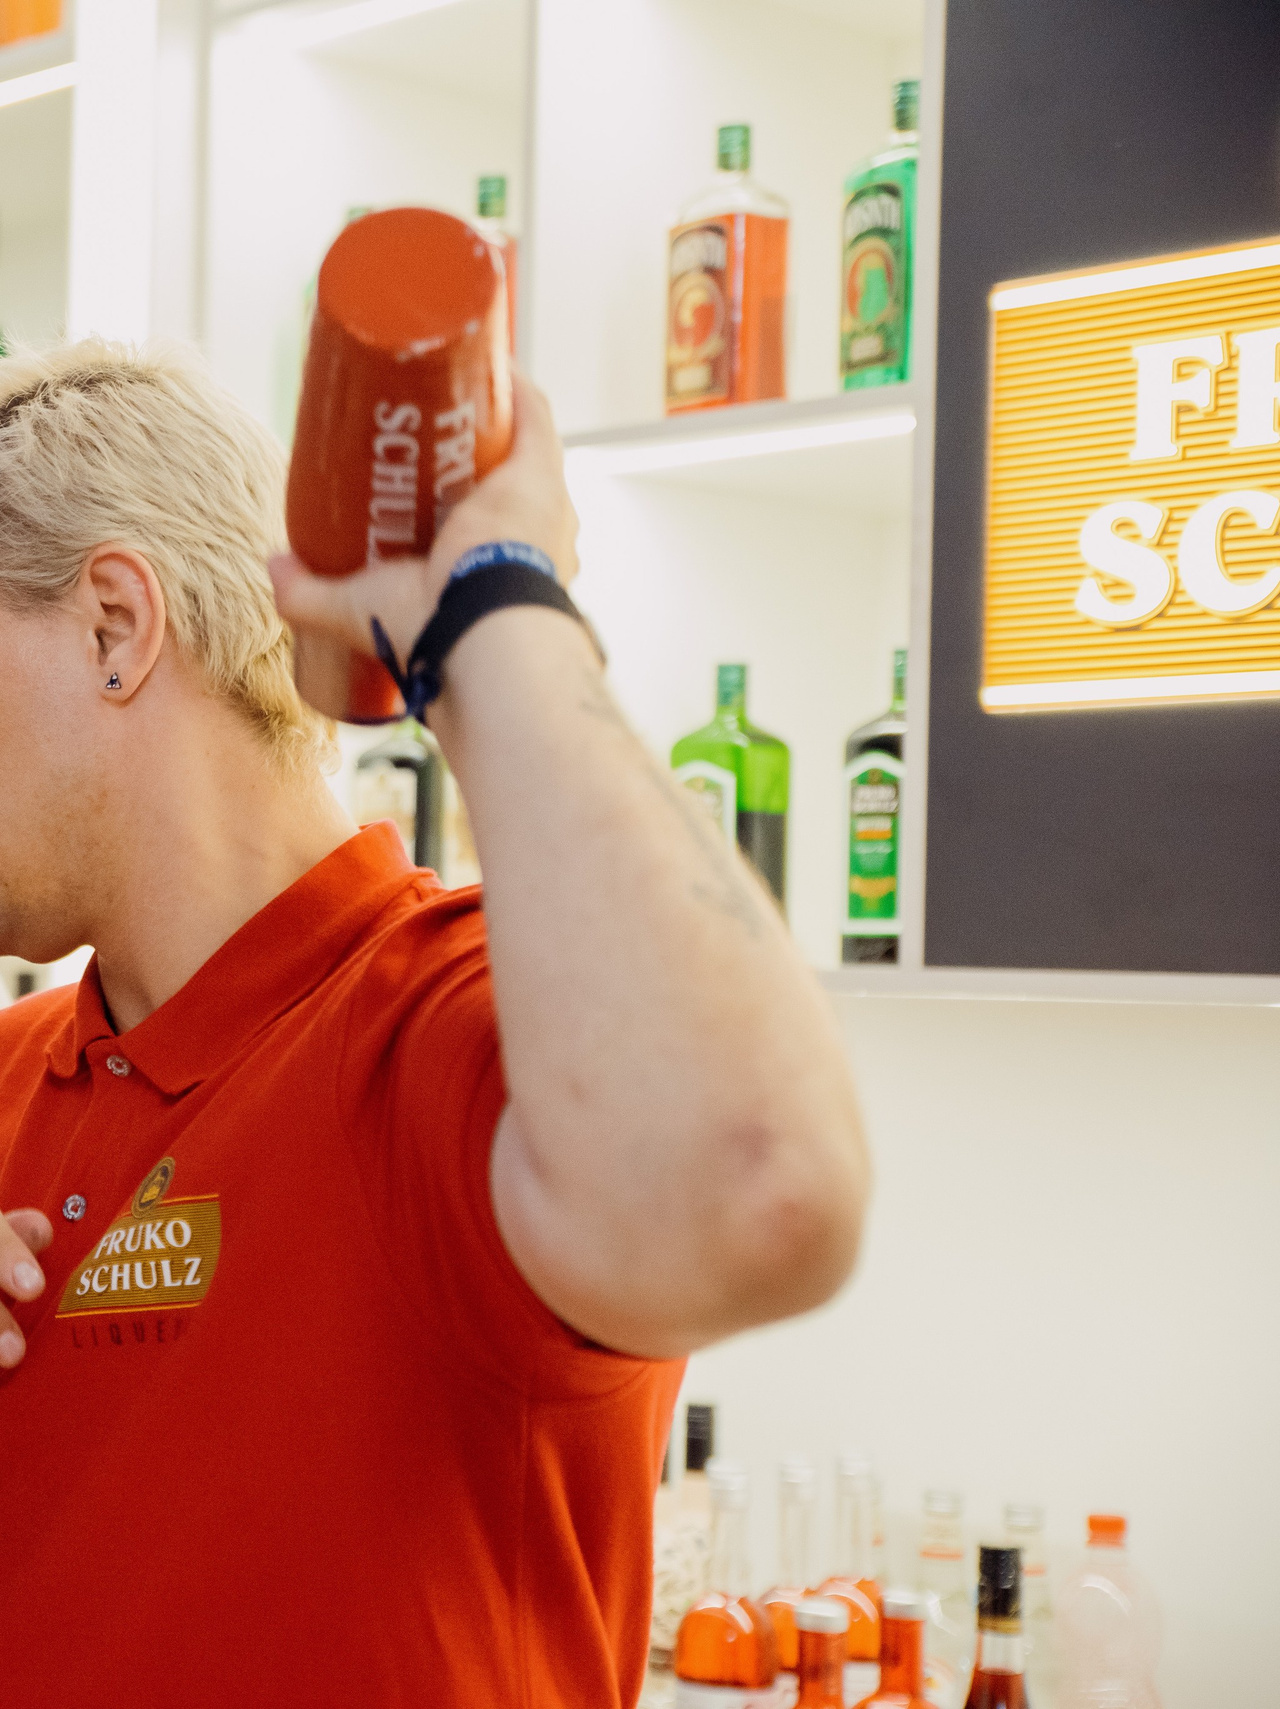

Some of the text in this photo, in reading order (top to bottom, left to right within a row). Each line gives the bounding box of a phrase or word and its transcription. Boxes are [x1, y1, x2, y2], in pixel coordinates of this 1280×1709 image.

[368, 402, 421, 568] SCHUL
[1075, 489, 1280, 629] SC
[76, 1257, 202, 1296] SCHULZ
[94, 1219, 192, 1260] FRUKO
